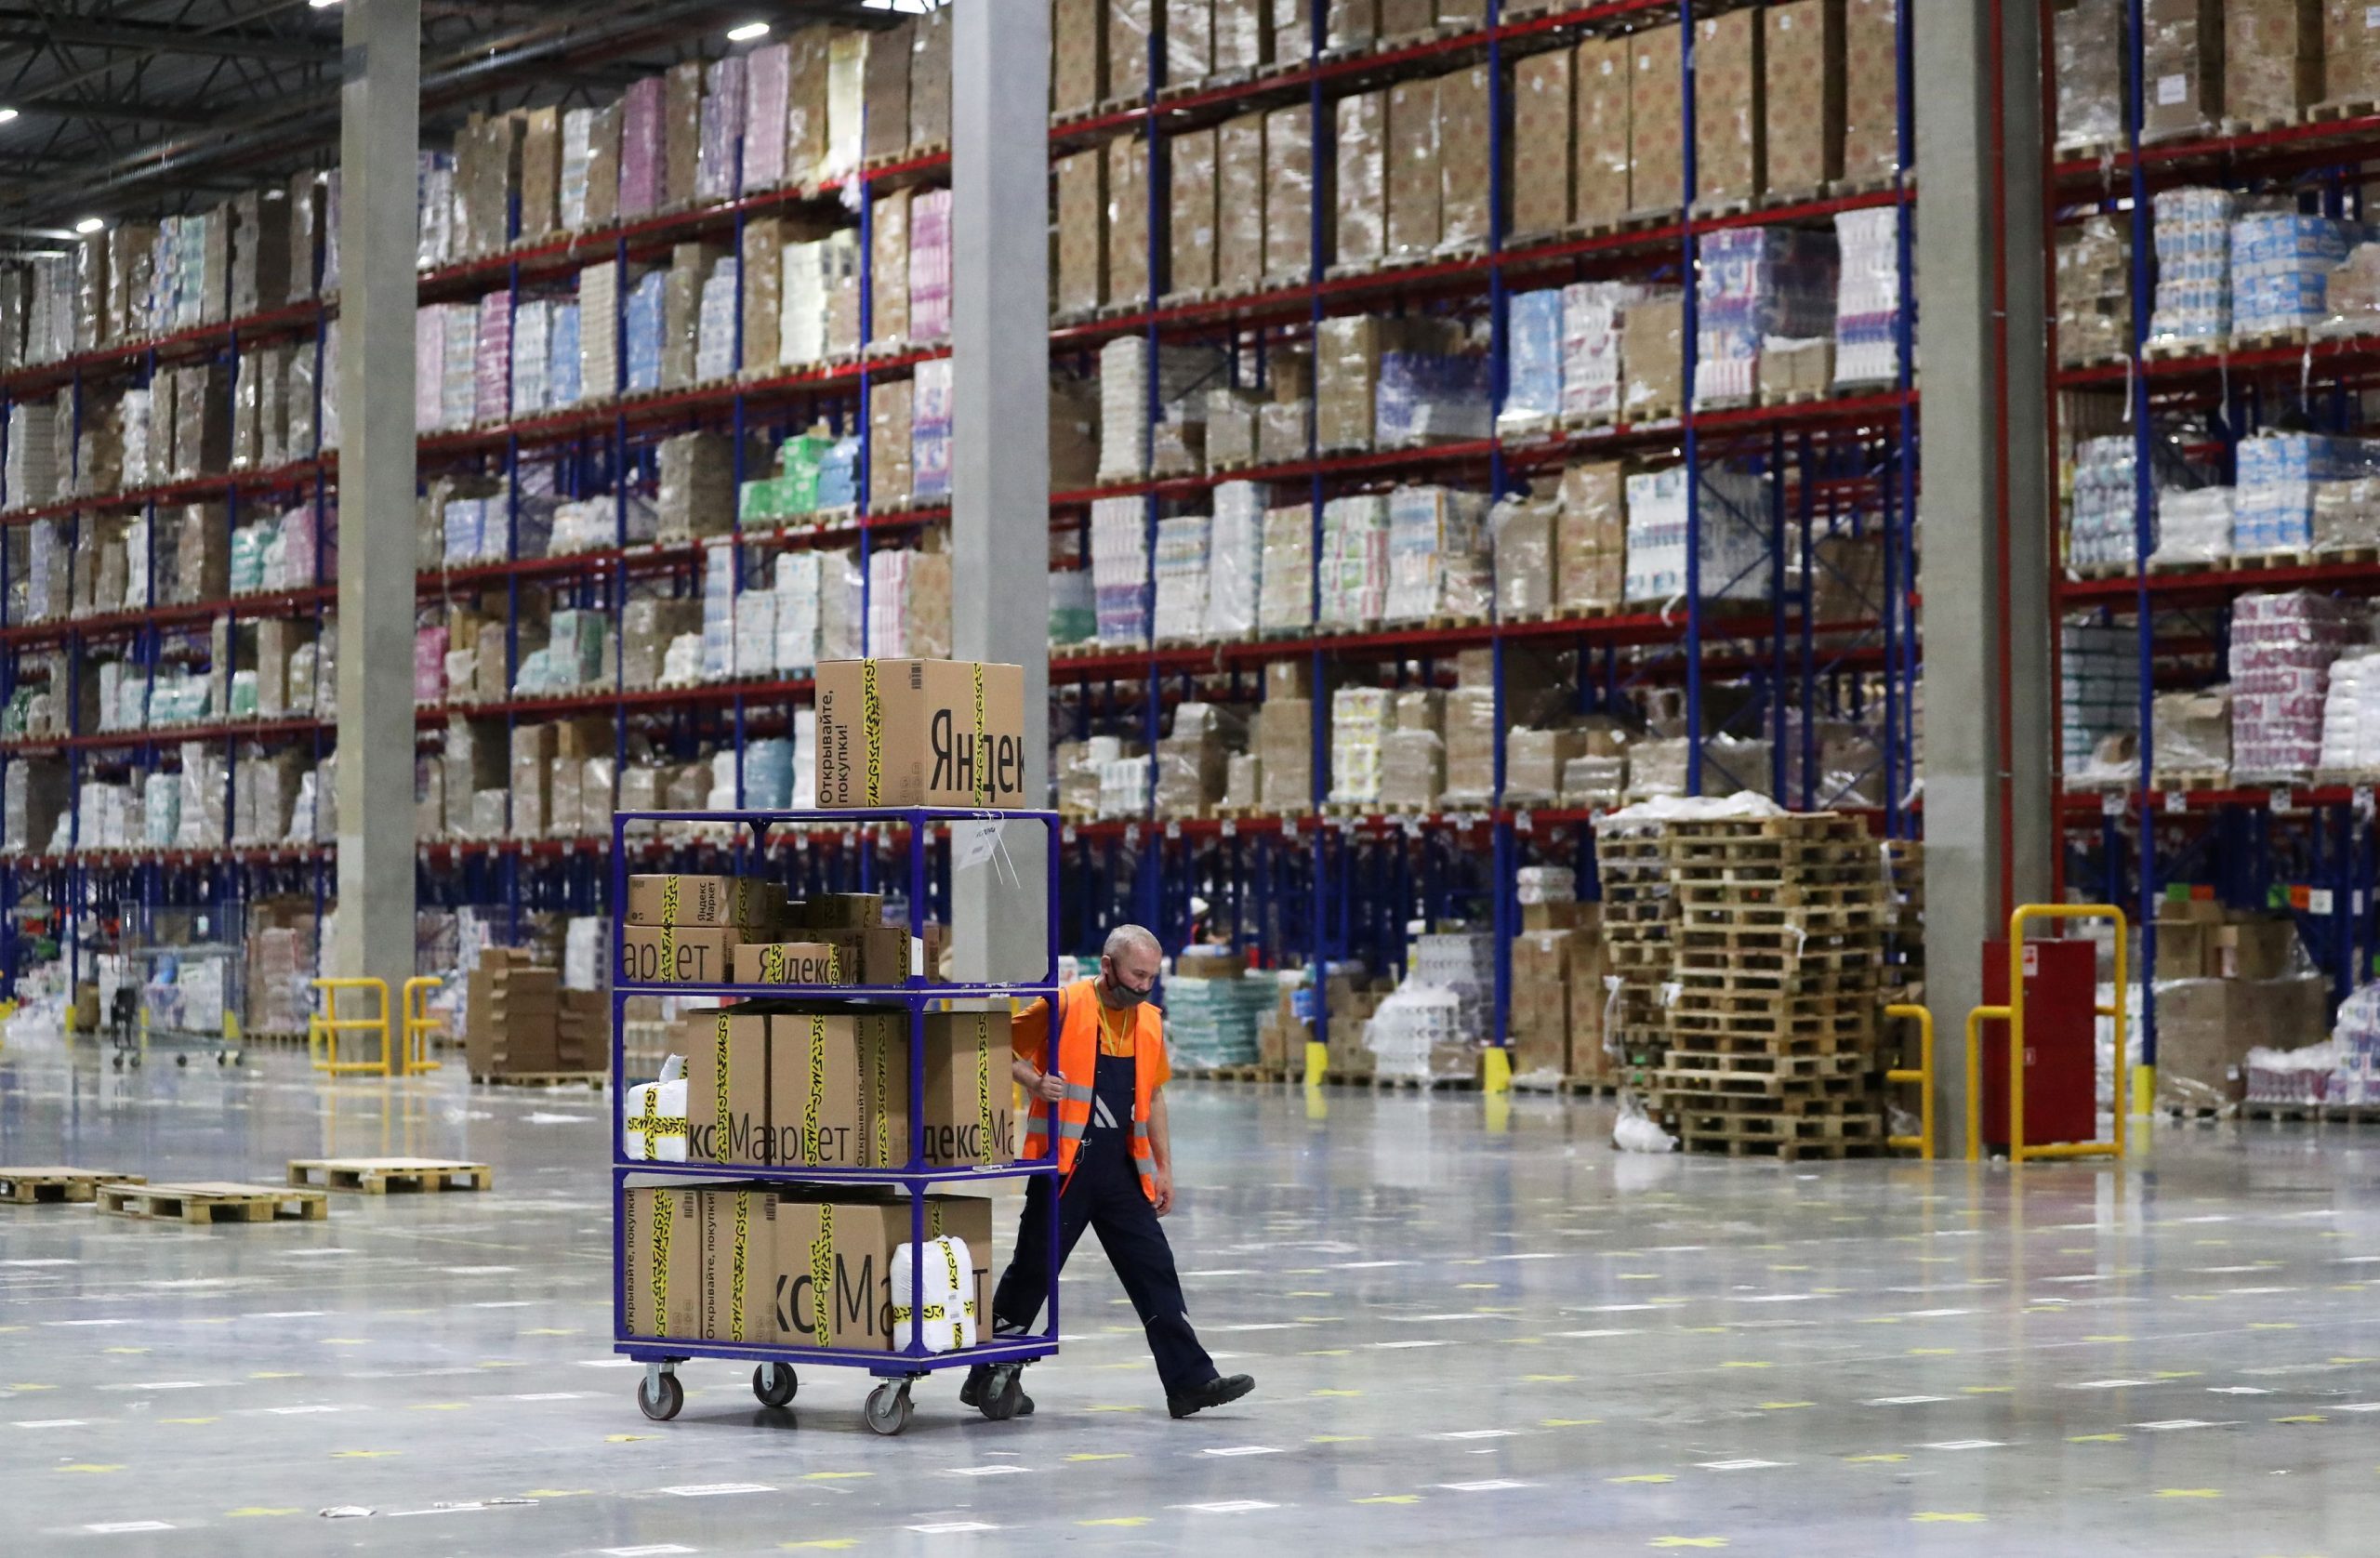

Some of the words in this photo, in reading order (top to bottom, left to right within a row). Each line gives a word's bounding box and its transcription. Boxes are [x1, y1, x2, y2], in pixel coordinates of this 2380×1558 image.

[819, 690, 834, 804] Открывайте,
[836, 724, 851, 803] покупки!
[697, 882, 707, 921] Яндекс
[707, 881, 717, 922] Маркет
[856, 1080, 866, 1167] Открывайте,
[627, 1190, 636, 1248] покупки!
[707, 1193, 717, 1251] покупки!
[626, 1251, 636, 1336] Открывайте,
[706, 1255, 716, 1340] Открывайте,
